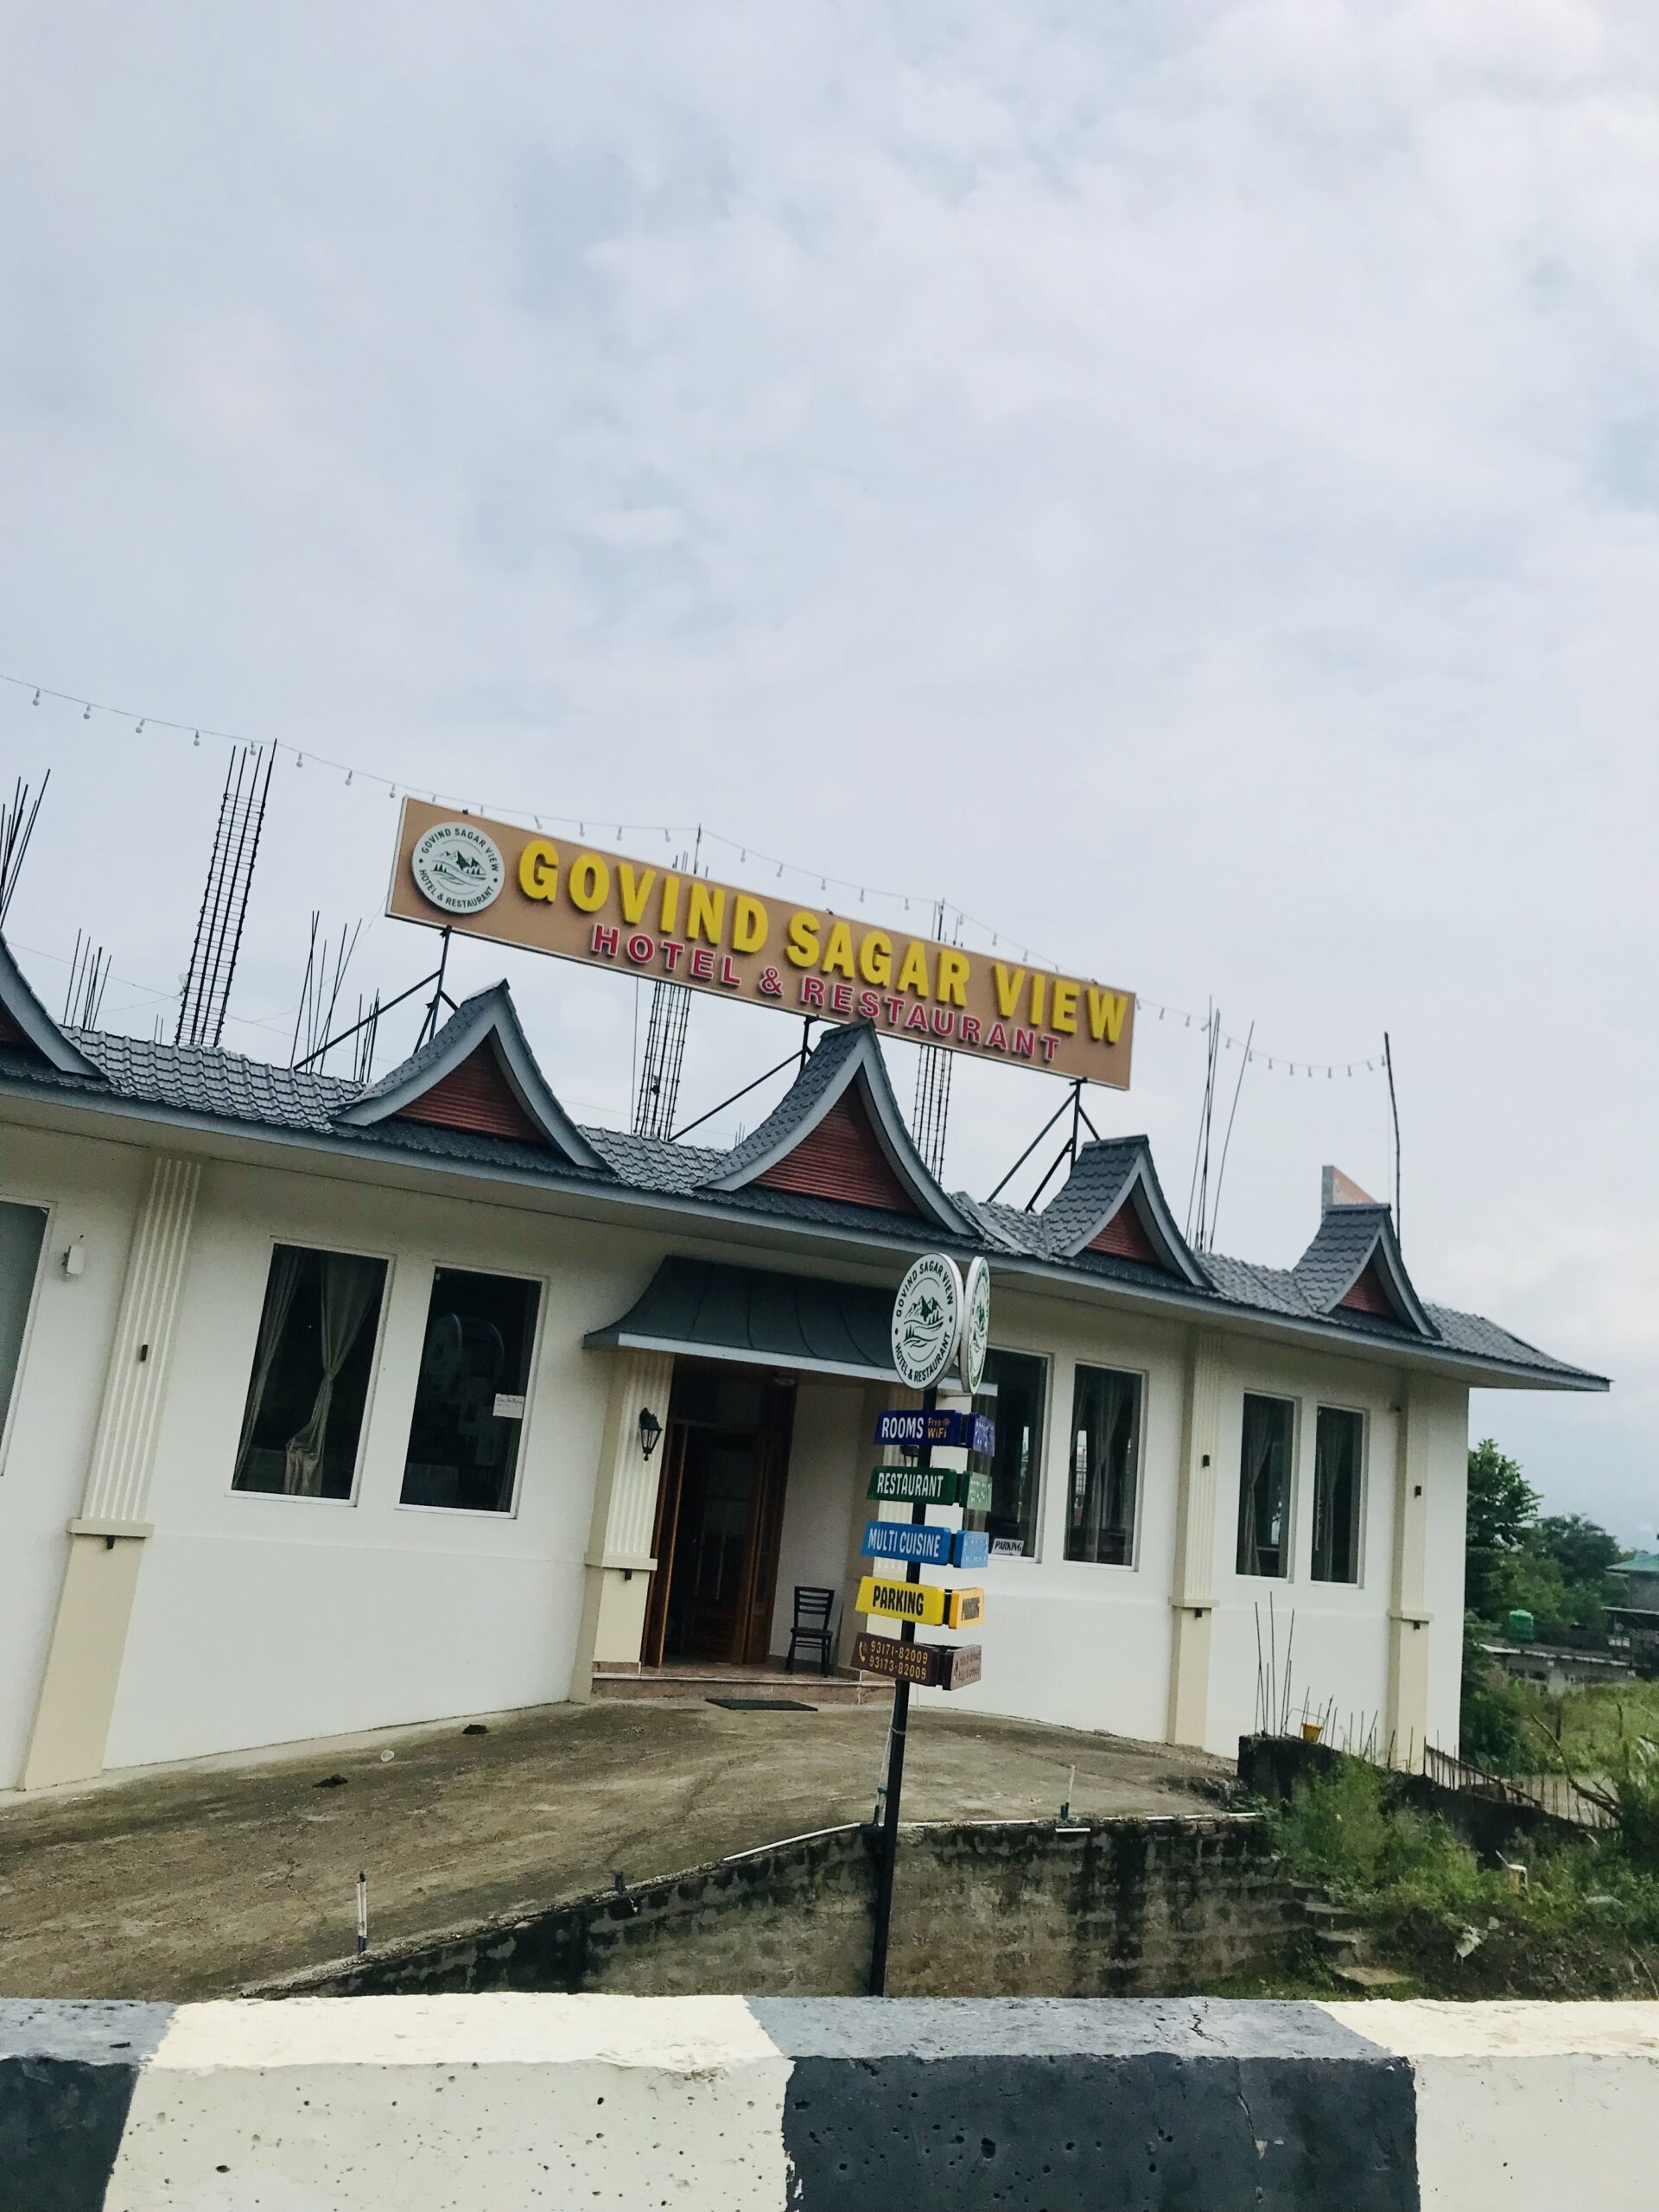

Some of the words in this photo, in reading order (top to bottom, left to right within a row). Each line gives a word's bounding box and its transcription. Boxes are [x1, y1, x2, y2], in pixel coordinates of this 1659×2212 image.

[421, 828, 451, 854] GOVIND
[454, 828, 486, 848] SAGAR
[485, 847, 499, 872] VIEW
[419, 869, 437, 895] HOTEL
[445, 886, 494, 908] RESTAURANT
[519, 840, 769, 953] GOVIND
[786, 912, 970, 1007] SAGAR
[994, 963, 1128, 1044] VIEW
[591, 923, 742, 987] HOTEL
[760, 966, 784, 995] &
[801, 976, 1062, 1062] RESTAURANT
[896, 1271, 918, 1318] GOVIND
[919, 1261, 944, 1277] SAGAR
[942, 1272, 954, 1306] VIEW
[895, 1342, 909, 1376] HOTEL
[913, 1331, 951, 1382] RESTAURANT
[881, 1417, 925, 1439] ROOMS
[877, 1472, 944, 1497] RESTAURANT
[868, 1528, 898, 1552] MULTI
[899, 1531, 941, 1558] CUISINE
[995, 1541, 1023, 1552] PARKING
[873, 1586, 924, 1616] PARKING
[870, 1640, 928, 1664] 93171-82009
[869, 1655, 926, 1680] 93173-82009
